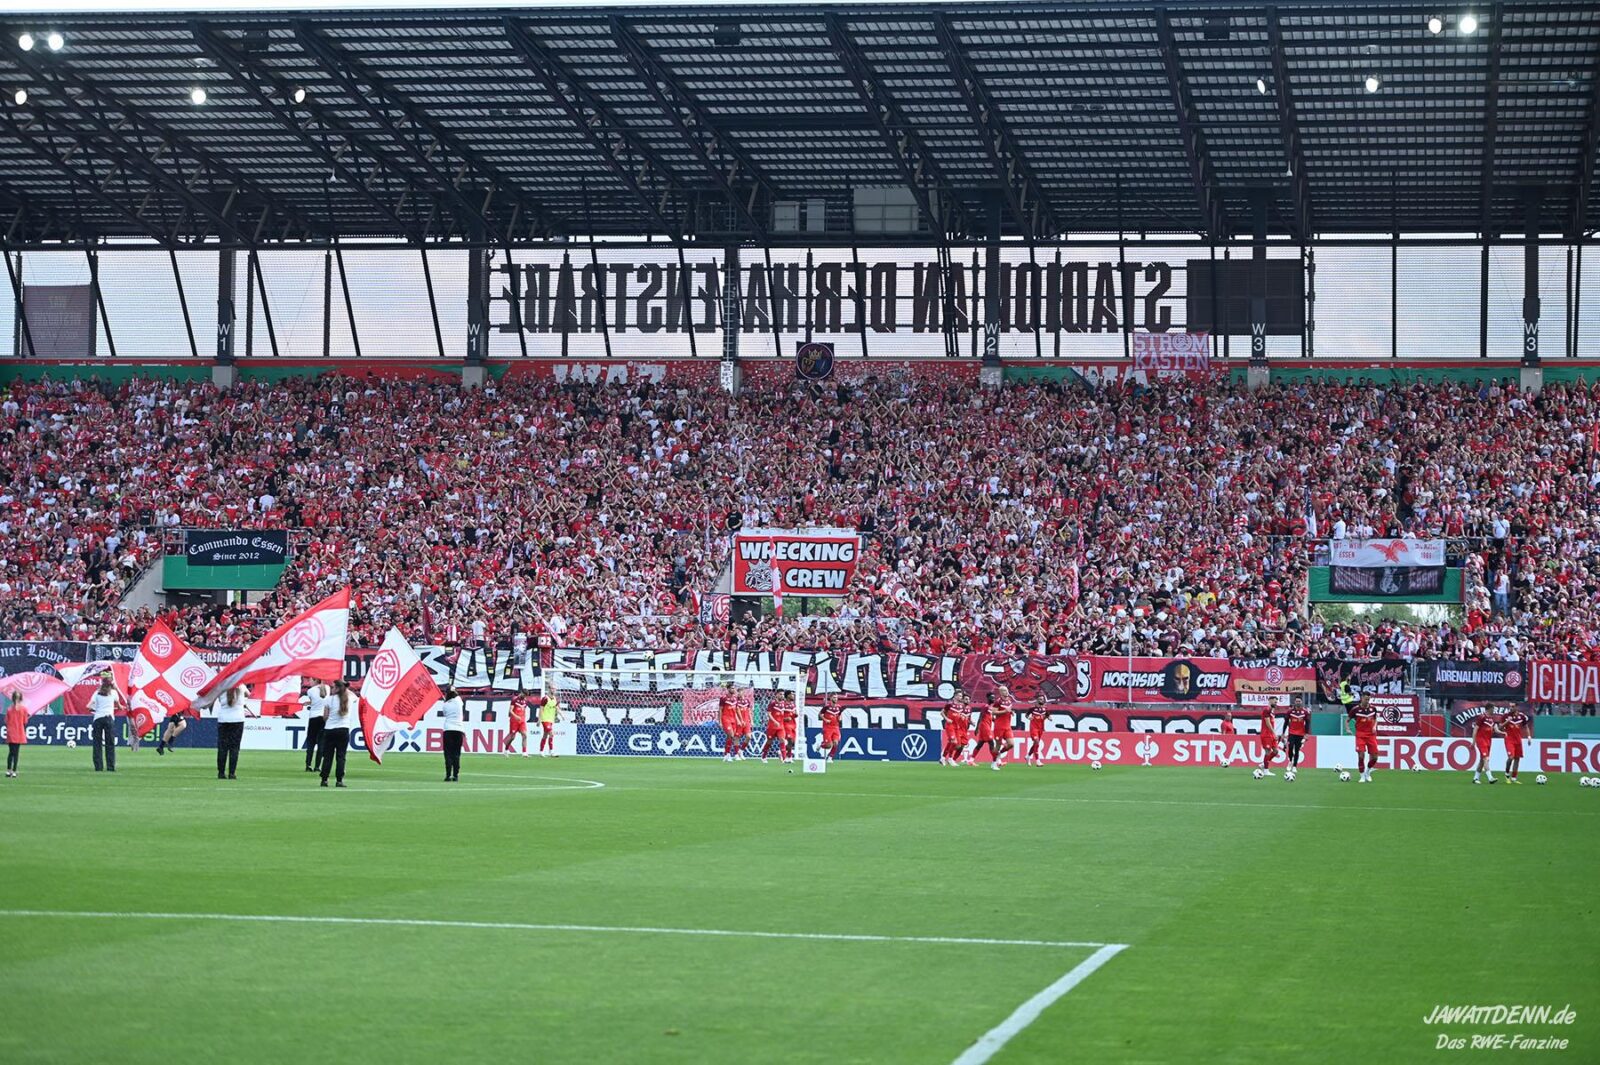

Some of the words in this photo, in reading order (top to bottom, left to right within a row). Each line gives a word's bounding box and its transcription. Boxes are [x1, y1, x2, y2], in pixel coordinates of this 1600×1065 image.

[1135, 352, 1209, 370] KASTEN
[189, 536, 249, 555] Commando
[252, 537, 284, 554] Essen
[739, 541, 854, 562] WRECKING
[239, 552, 260, 560] 2012
[785, 568, 847, 589] CREW
[1103, 672, 1166, 687] NORTHSIDE
[1196, 672, 1230, 688] CREW
[1436, 667, 1481, 683] ADRENALIN
[1483, 671, 1504, 684] BOYS
[1377, 739, 1477, 770] ERGO
